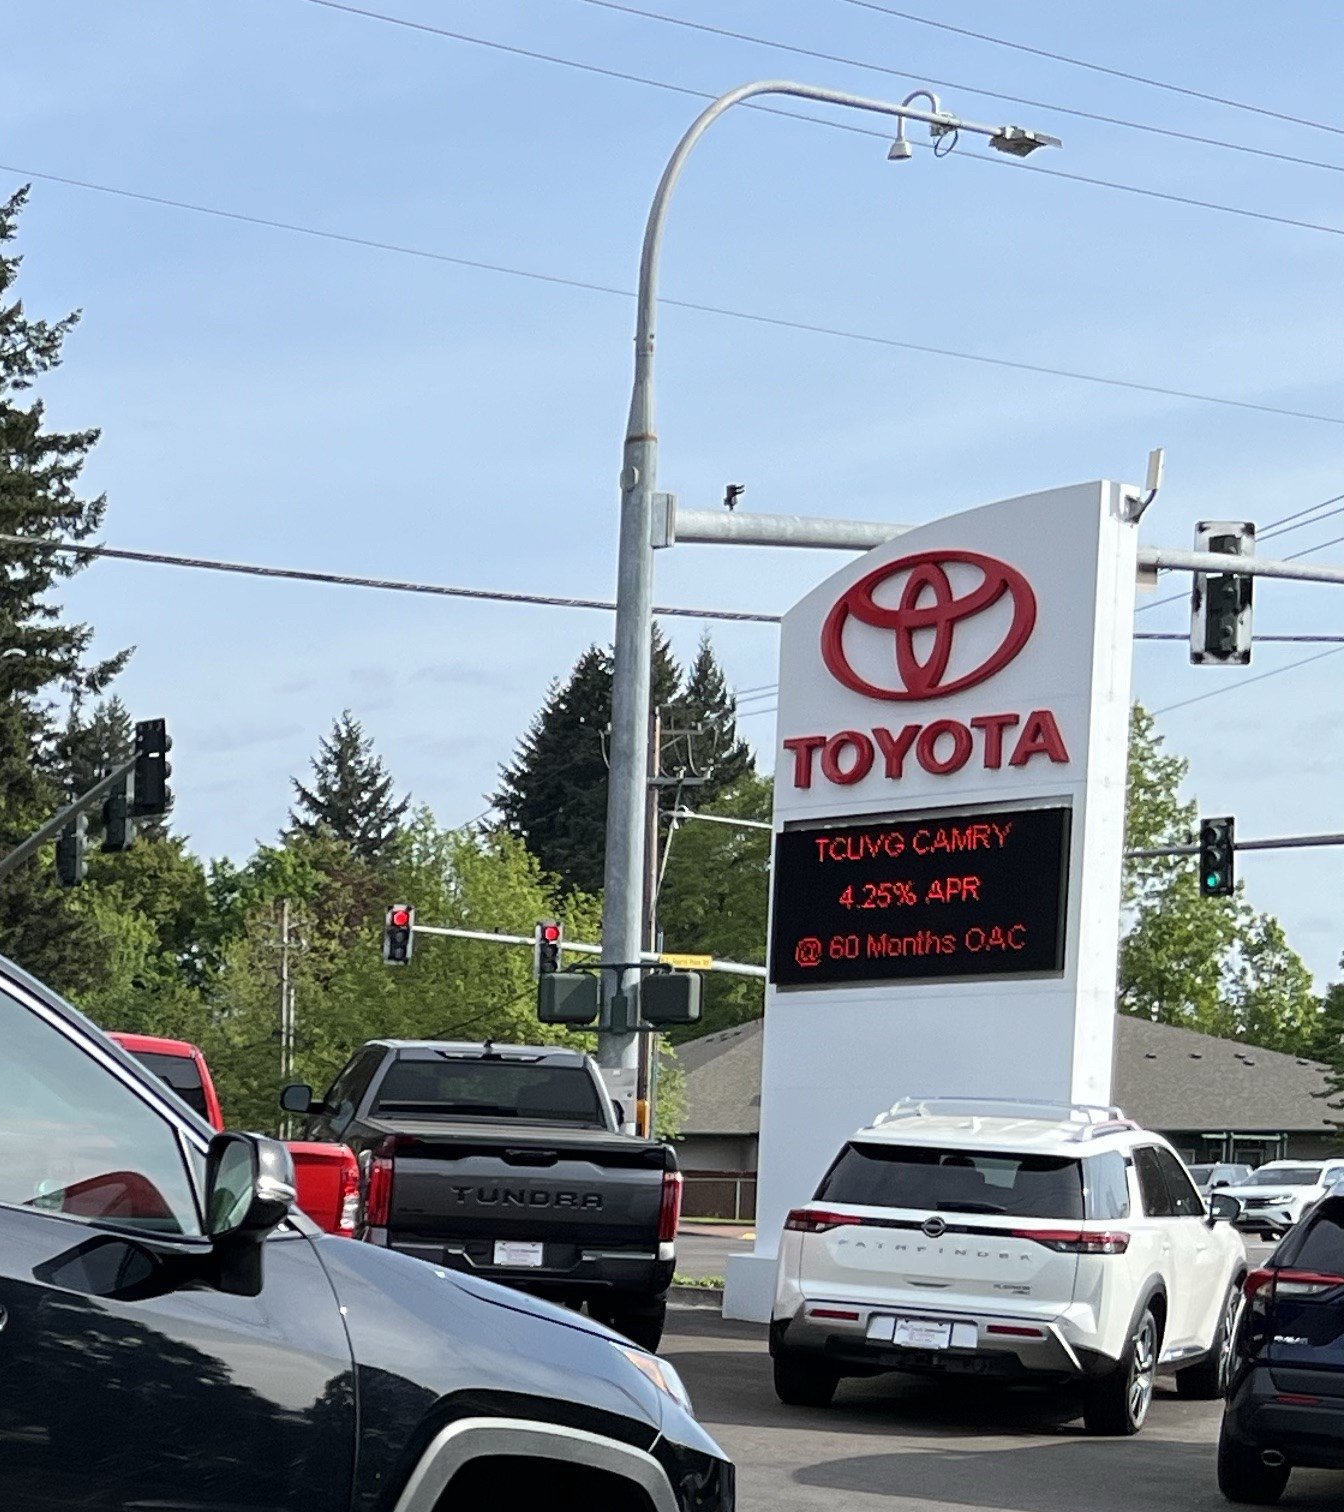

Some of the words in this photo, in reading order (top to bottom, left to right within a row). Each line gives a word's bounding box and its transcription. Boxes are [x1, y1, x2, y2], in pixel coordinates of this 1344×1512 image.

[783, 710, 1070, 789] TOYOTA
[815, 832, 905, 863] TCUVG
[912, 821, 1013, 856] CAMRY
[838, 880, 917, 910] 4.25%
[924, 875, 982, 905] APR
[829, 934, 860, 960] 60
[866, 929, 956, 959] Months
[449, 1185, 604, 1211] TUNDRA
[837, 1239, 1032, 1262] PATHFINDER
